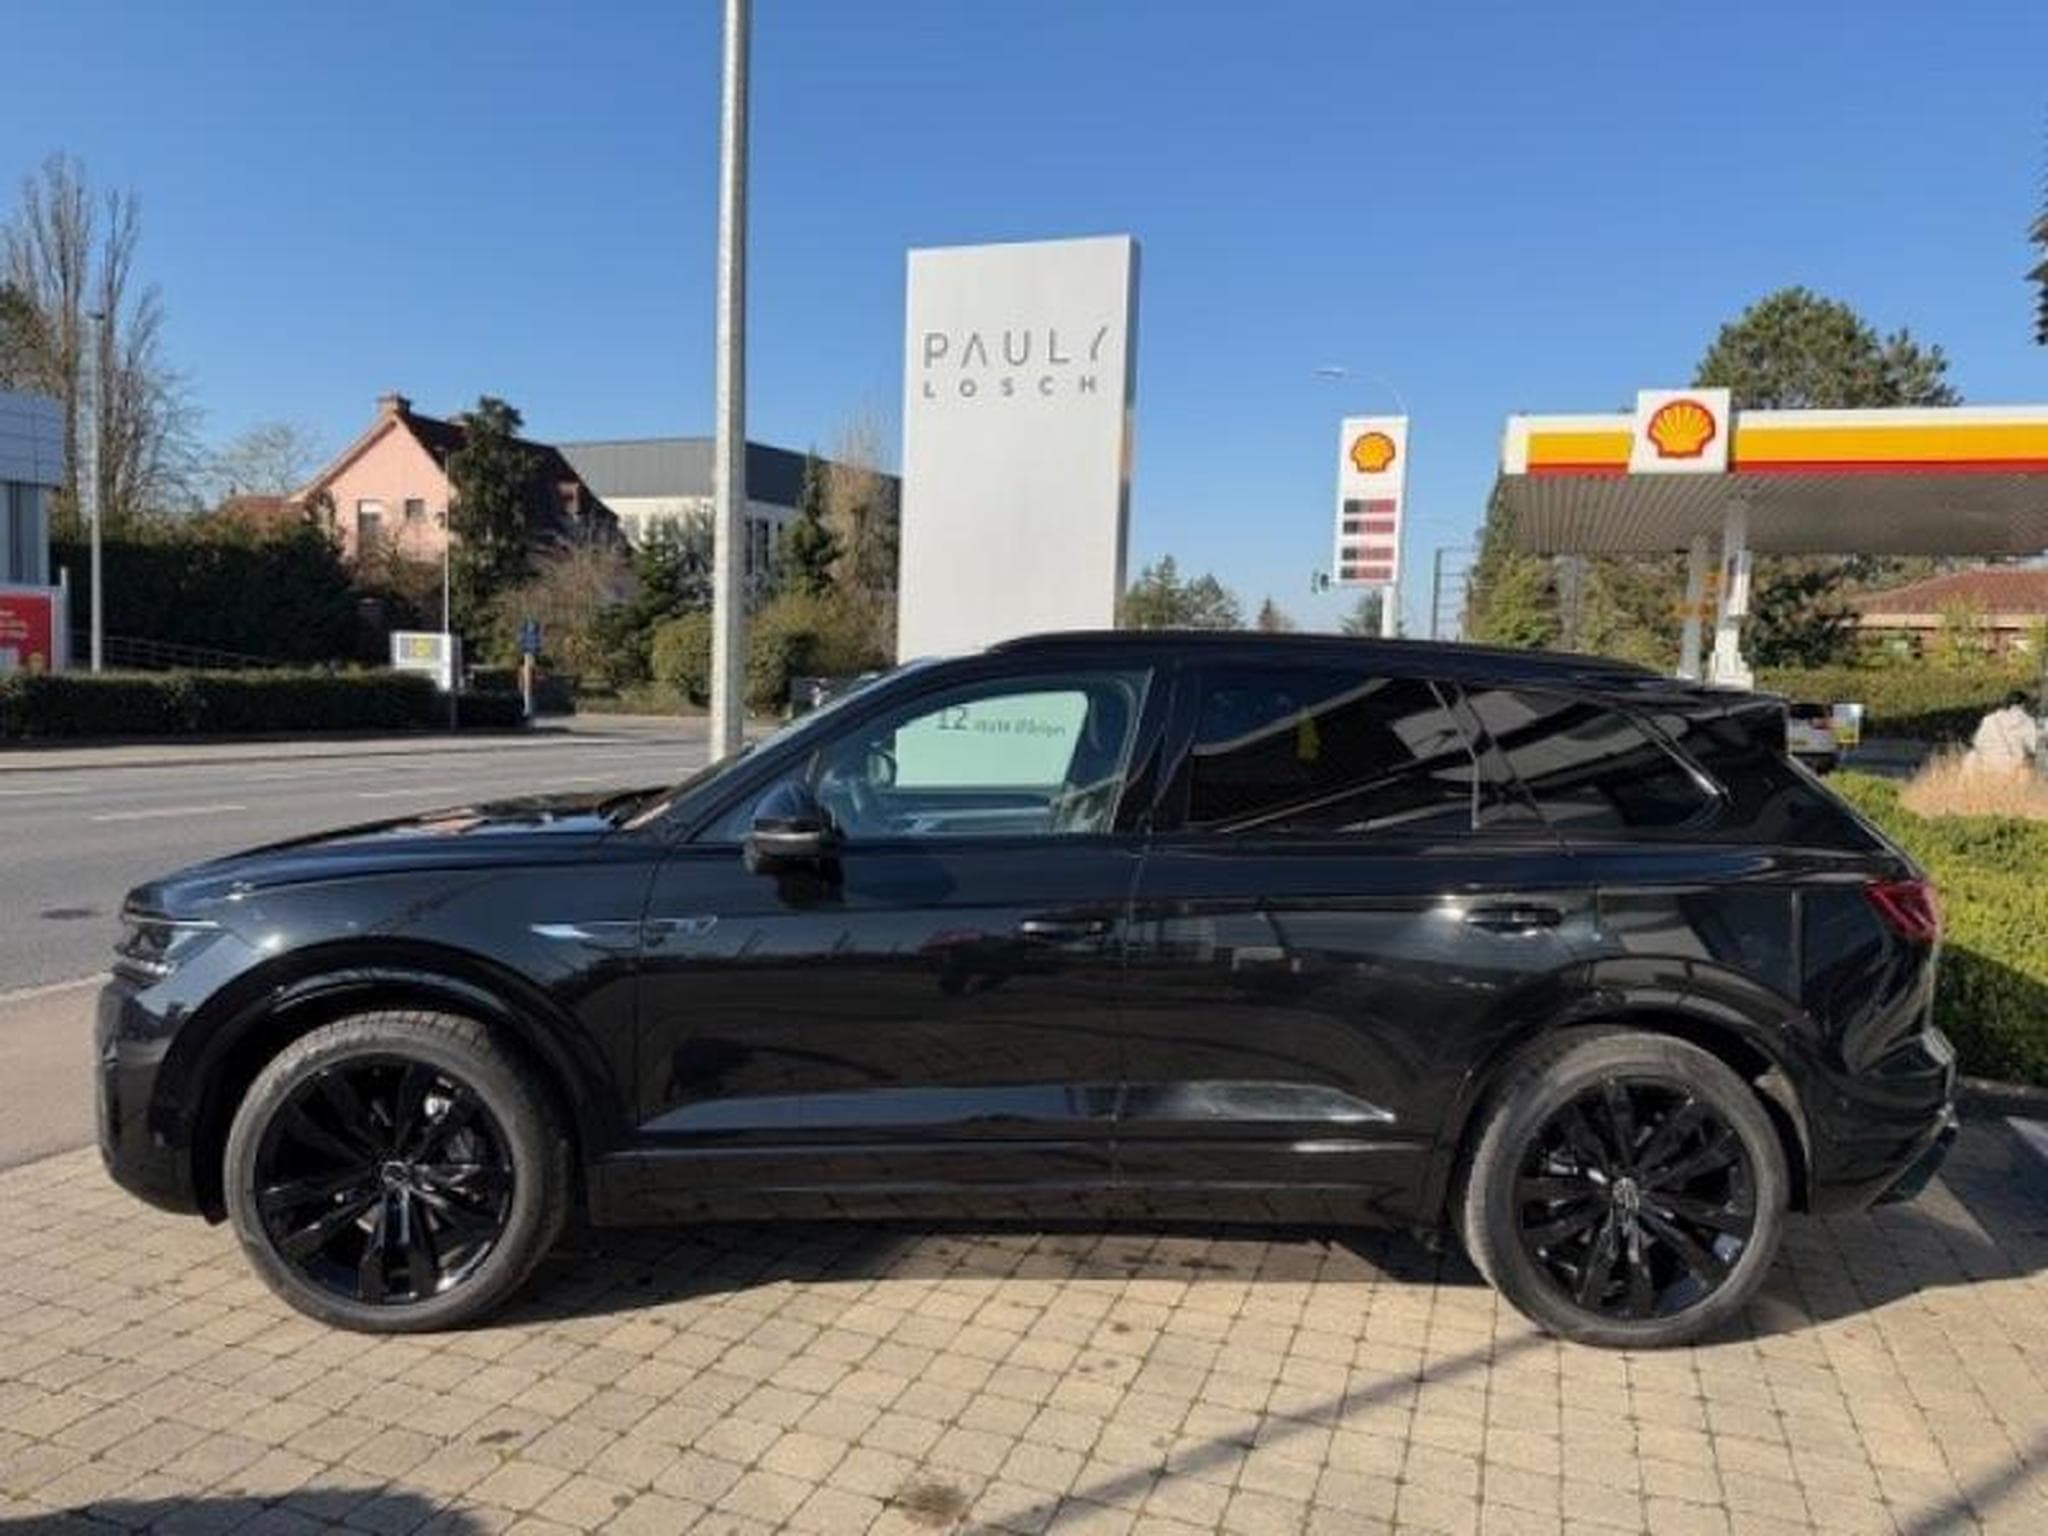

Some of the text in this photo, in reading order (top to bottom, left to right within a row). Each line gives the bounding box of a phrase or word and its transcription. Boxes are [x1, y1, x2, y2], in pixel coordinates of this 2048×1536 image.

[923, 326, 1109, 369] PAULY
[923, 374, 1098, 399] LOSCH
[938, 705, 968, 731] 12
